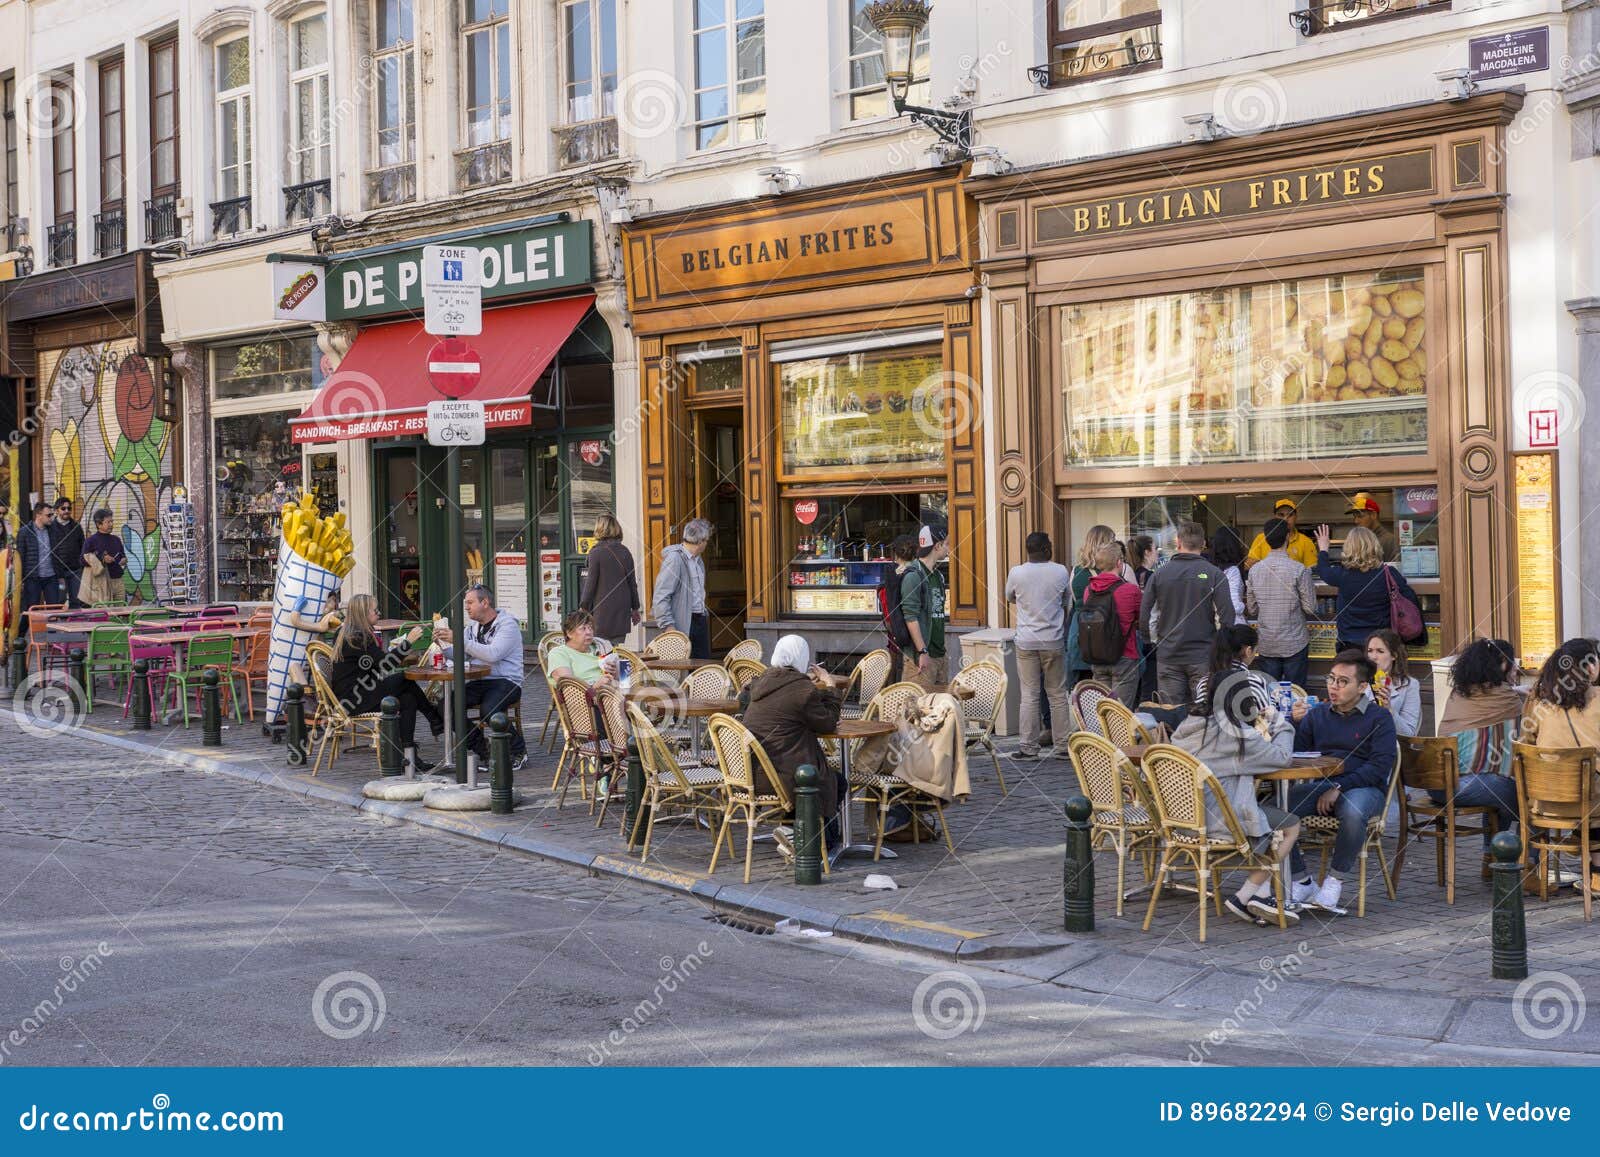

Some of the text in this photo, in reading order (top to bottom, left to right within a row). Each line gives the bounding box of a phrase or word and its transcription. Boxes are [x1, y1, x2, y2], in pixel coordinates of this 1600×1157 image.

[1480, 54, 1537, 72] MAGDALENA
[1482, 43, 1535, 60] MADELEINE
[1073, 164, 1386, 233] BELGIAN FRITES
[439, 249, 466, 258] ZONE
[681, 221, 894, 273] BELGIAN FRITES
[342, 234, 565, 309] DE PIOLEI
[295, 425, 341, 439] SANDWICH
[347, 419, 399, 435] BREAKFAST
[405, 417, 428, 430] REST
[484, 407, 525, 423] ELIVERY
